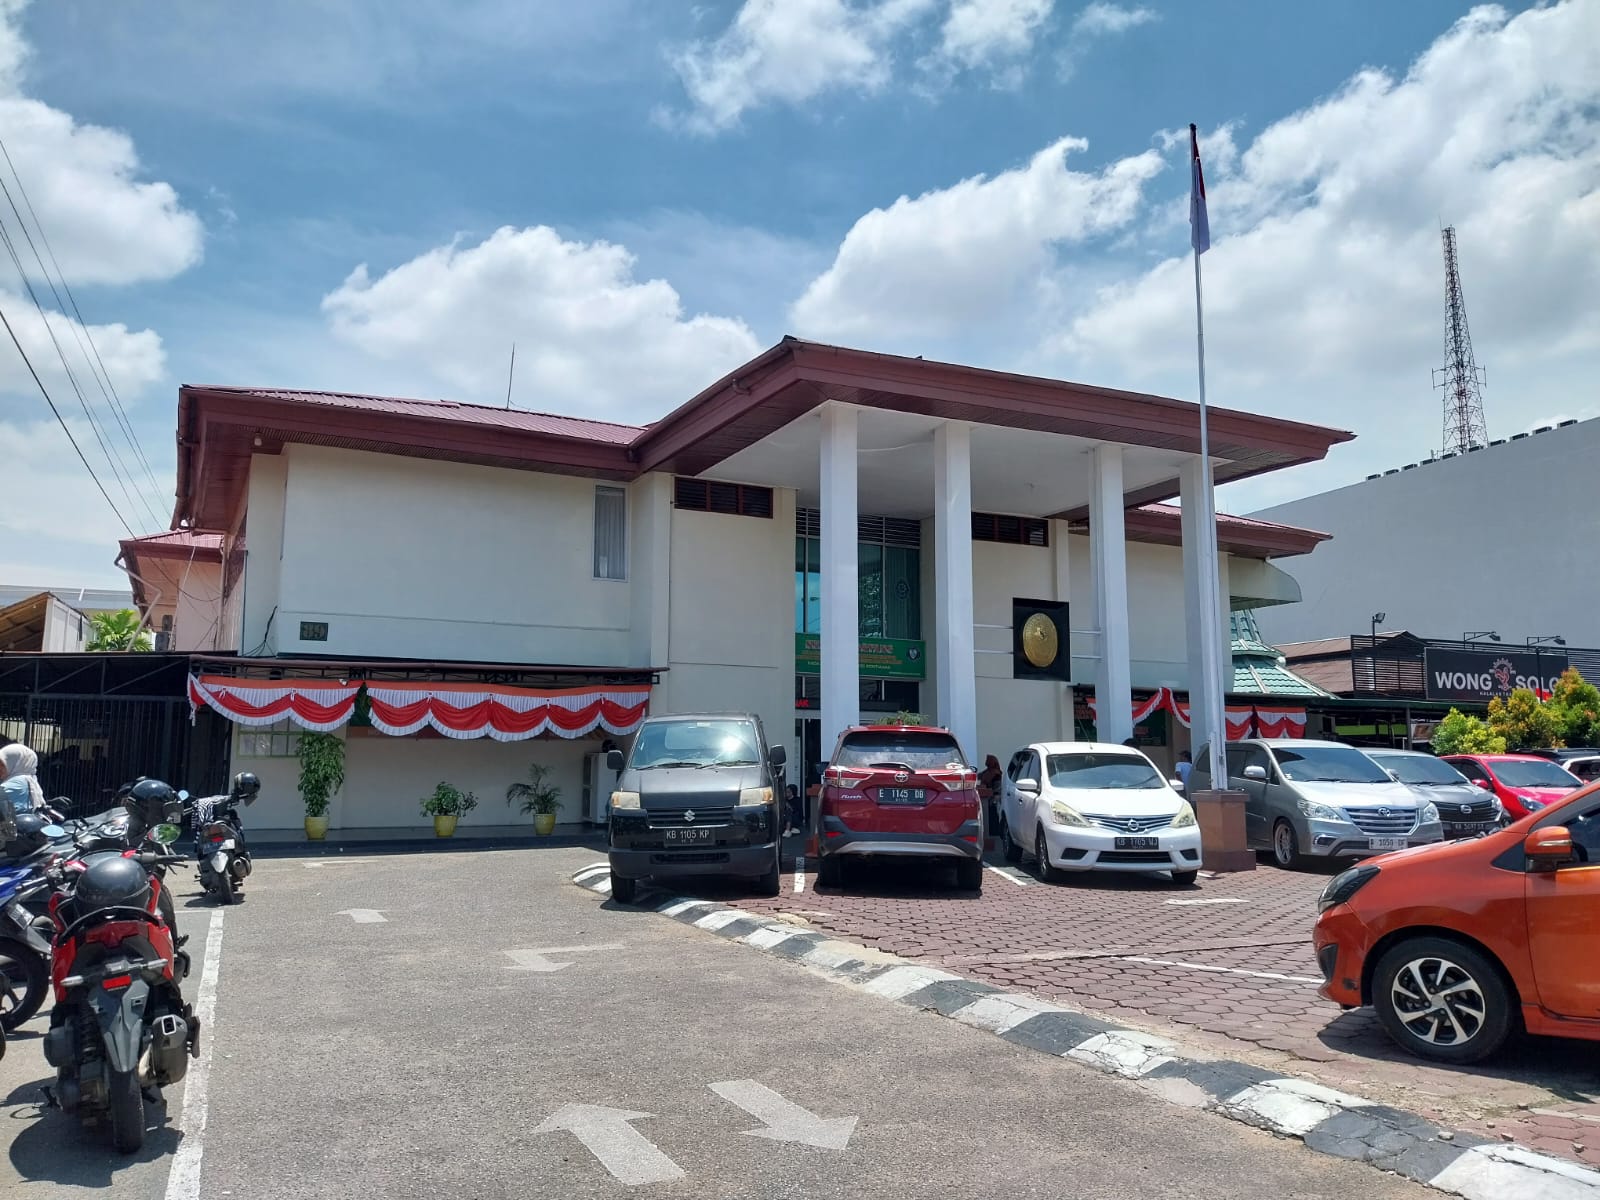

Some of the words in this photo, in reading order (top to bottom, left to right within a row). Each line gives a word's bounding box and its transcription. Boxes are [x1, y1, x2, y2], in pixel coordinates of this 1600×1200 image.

[1435, 671, 1492, 690] WONG
[879, 789, 884, 798] E
[892, 789, 909, 798] 1145
[666, 830, 676, 839] KB
[680, 829, 697, 839] 1105
[699, 829, 710, 839] KP
